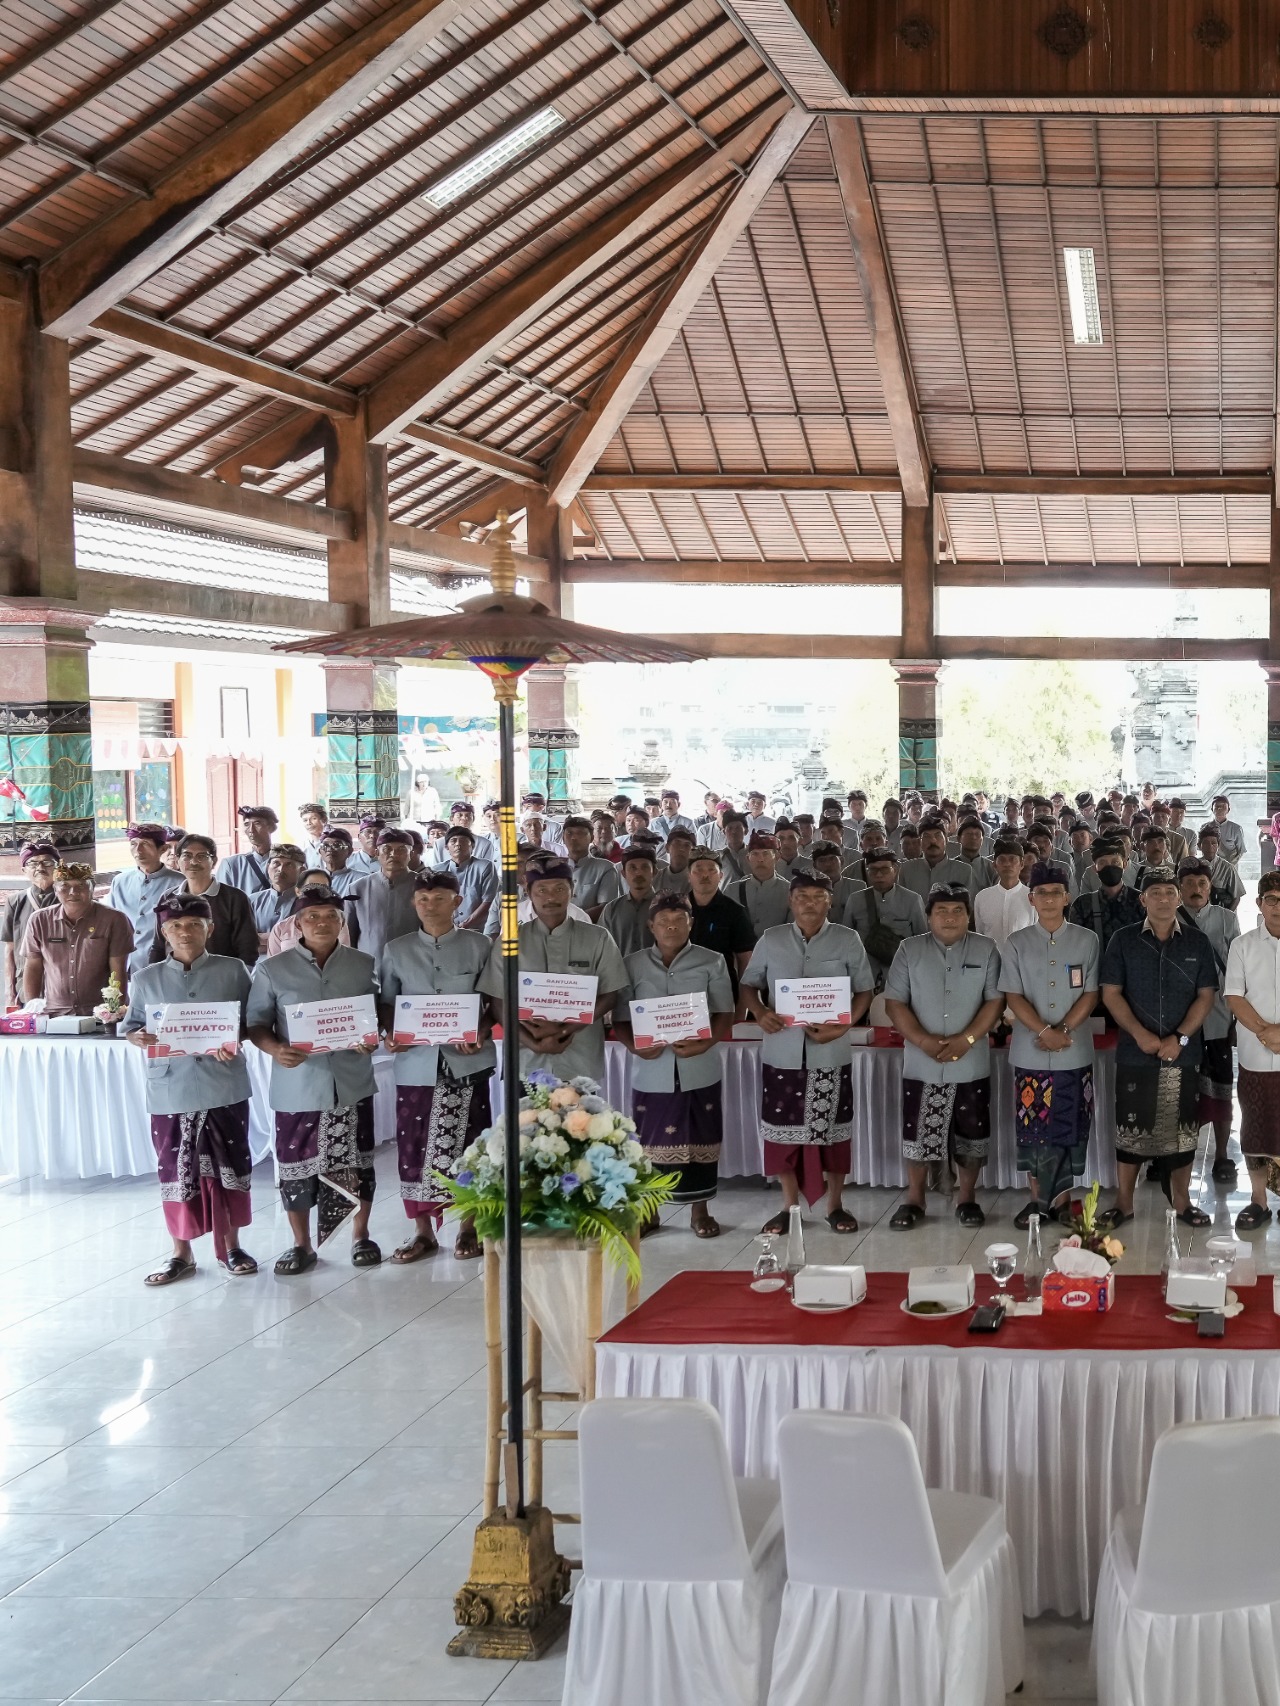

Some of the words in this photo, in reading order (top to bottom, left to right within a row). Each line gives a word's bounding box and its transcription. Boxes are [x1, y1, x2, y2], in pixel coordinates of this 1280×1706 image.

[523, 997, 592, 1007] TRANSPLANTER
[657, 1001, 689, 1009] BANTUAN
[318, 1004, 354, 1013] BANTUAN
[316, 1015, 354, 1026] MOTOR
[656, 1020, 694, 1030] SINGKAL
[158, 1024, 234, 1034] CULTIVATOR
[318, 1026, 347, 1035] RODA
[1065, 1294, 1087, 1304] jolly
